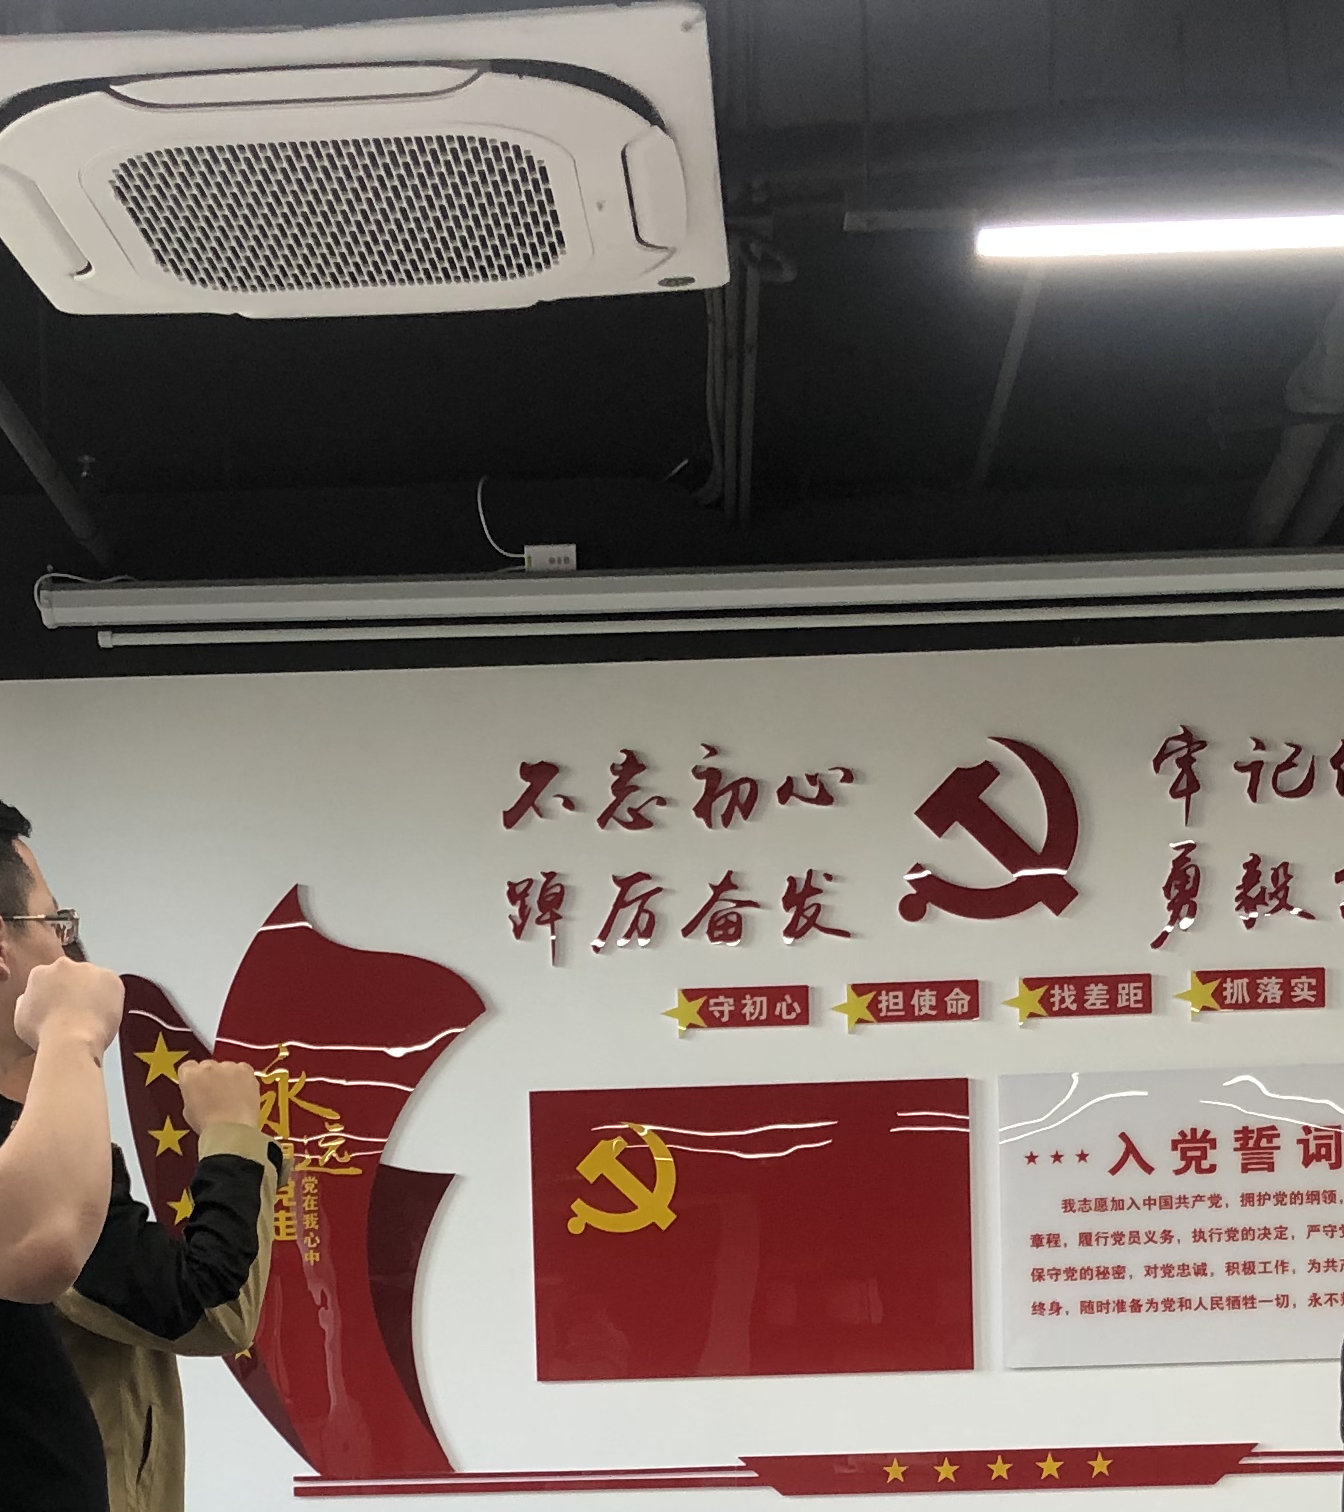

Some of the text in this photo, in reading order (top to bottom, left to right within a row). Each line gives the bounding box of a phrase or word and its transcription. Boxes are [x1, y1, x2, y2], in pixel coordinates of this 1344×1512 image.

[503, 743, 854, 830] 不忘初心
[506, 869, 852, 967] 踔厉奋发
[708, 994, 802, 1022] 守初心
[877, 987, 972, 1018] 担使命
[1050, 981, 1145, 1011] 找差距
[1222, 976, 1318, 1005] 抓落实
[258, 1043, 363, 1176] 永远
[1107, 1124, 1344, 1177] 入党誓词
[302, 1175, 321, 1266] 党在我心中
